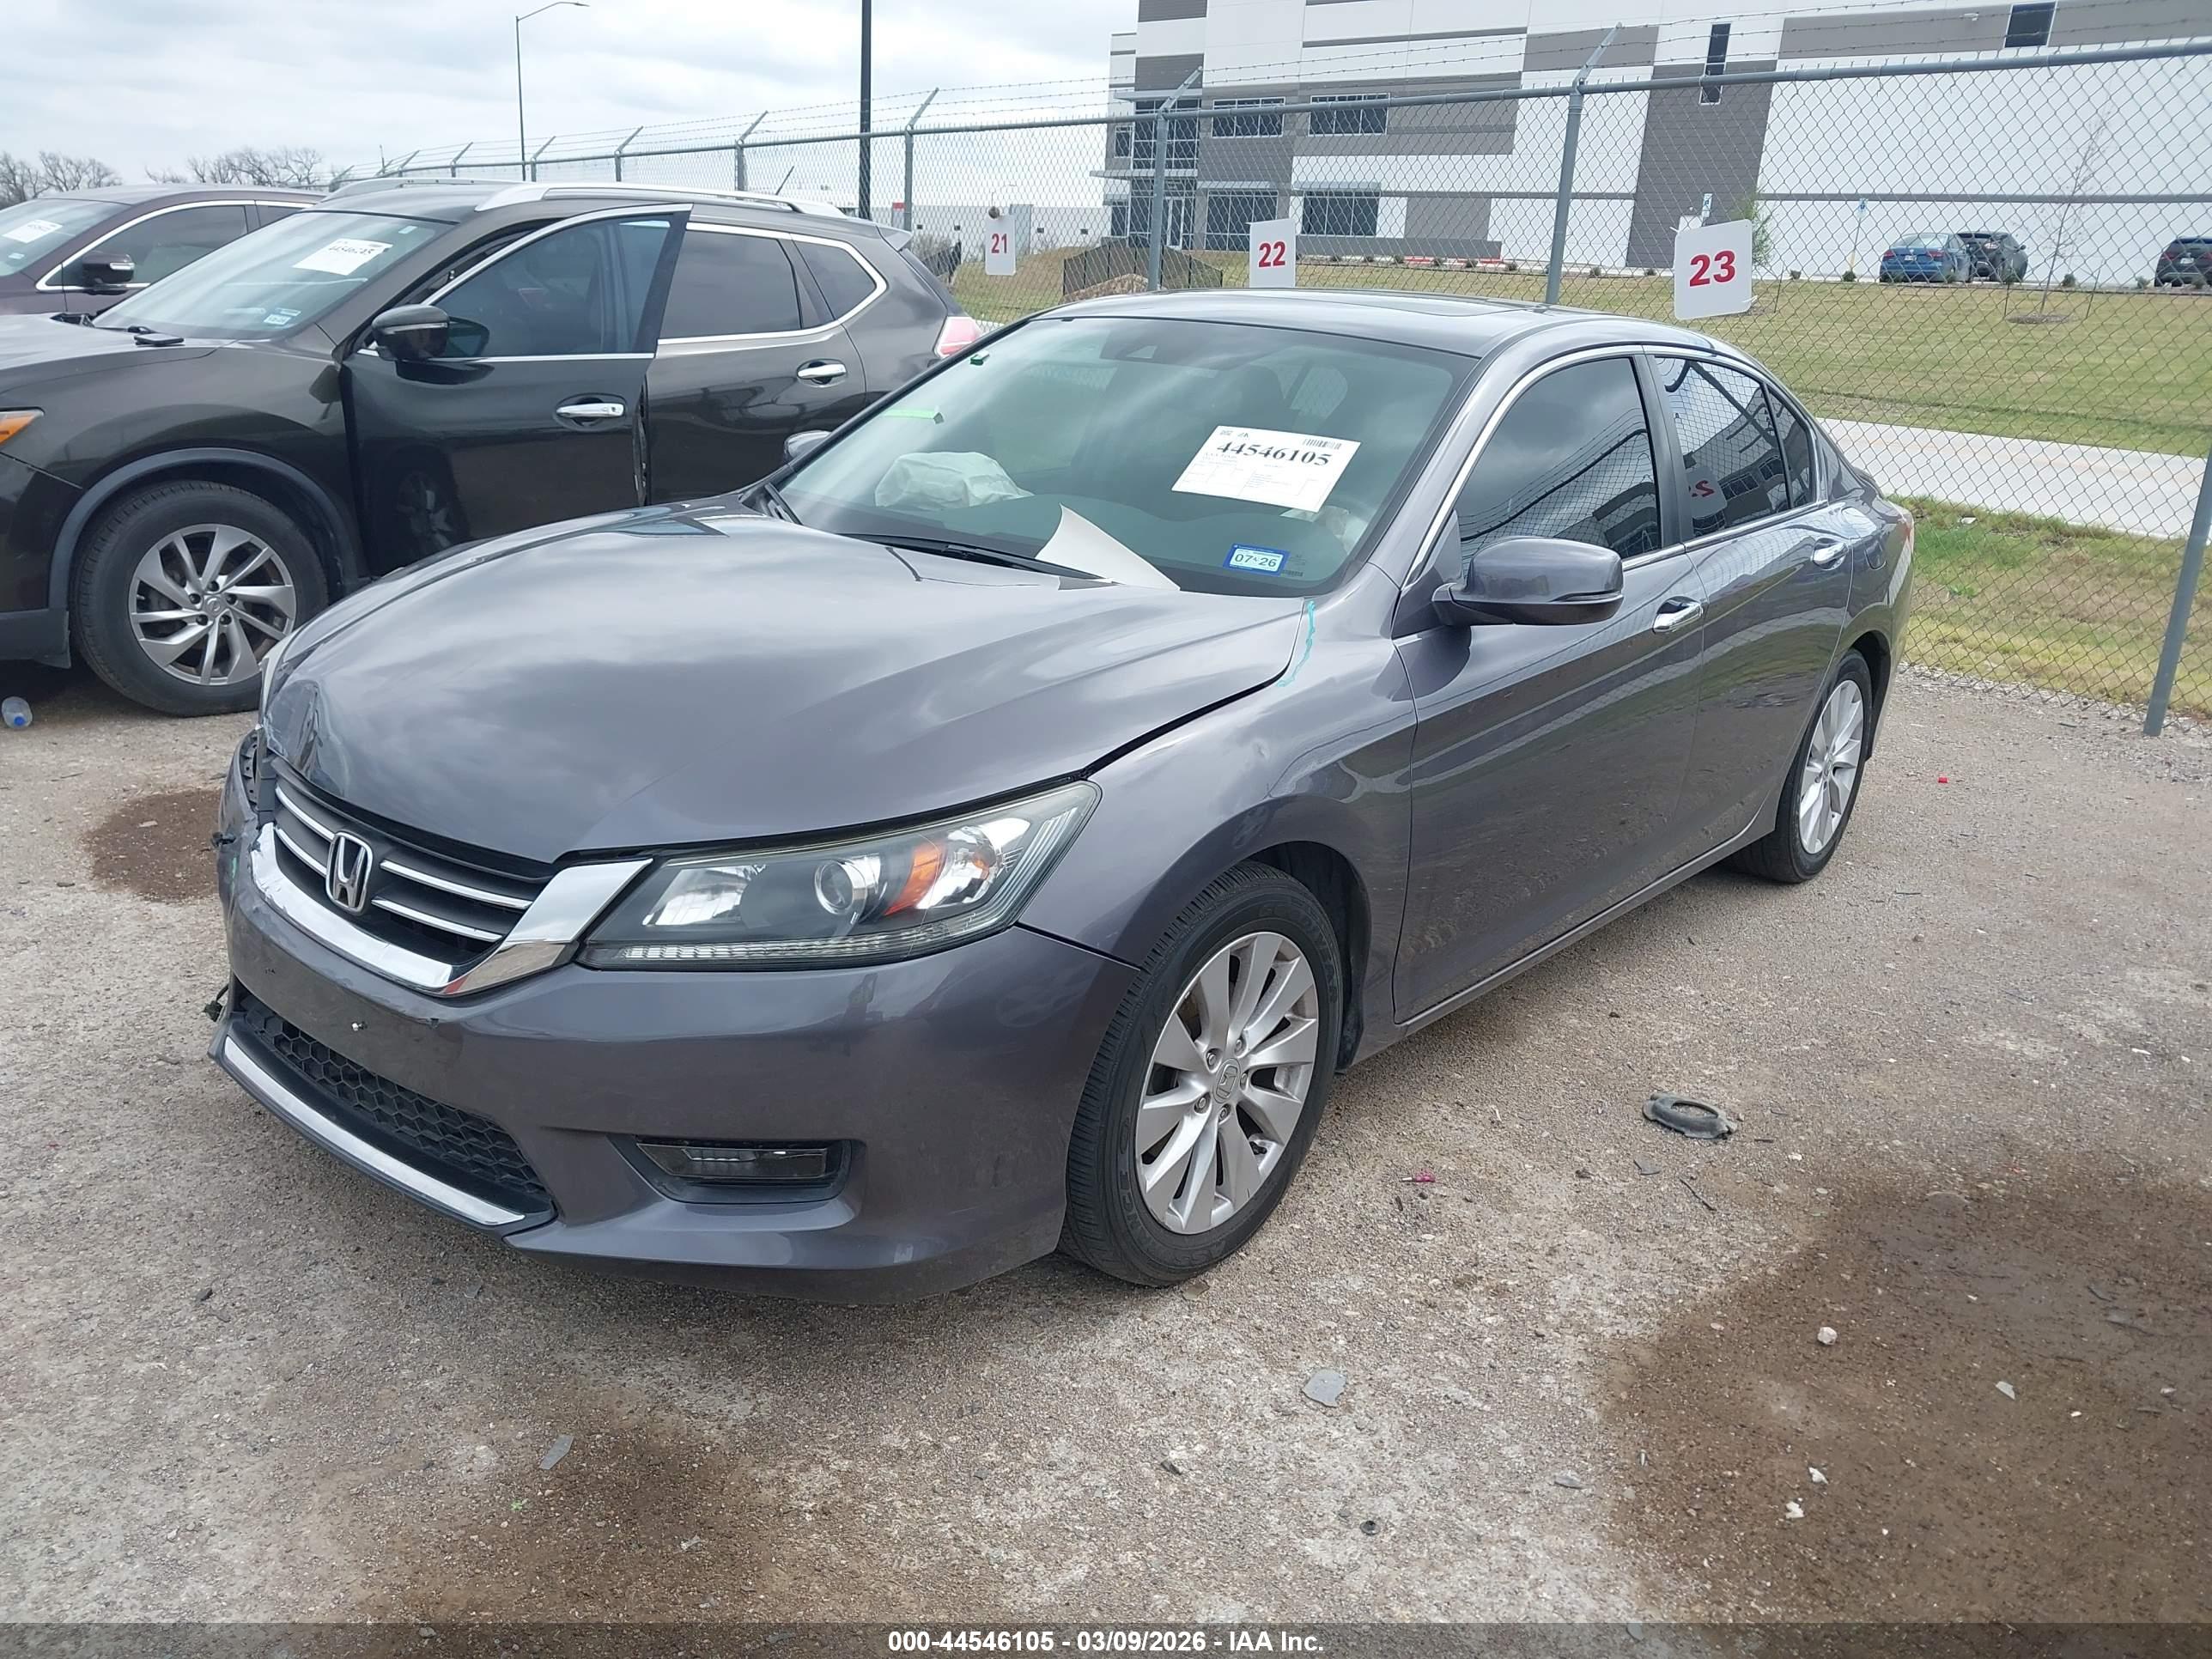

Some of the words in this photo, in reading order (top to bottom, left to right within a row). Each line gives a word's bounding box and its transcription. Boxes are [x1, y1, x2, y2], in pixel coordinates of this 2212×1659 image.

[991, 233, 1007, 253] 21
[1258, 240, 1286, 268] 22
[1689, 250, 1736, 288] 23
[1216, 441, 1333, 466] 44546105
[1234, 553, 1254, 563] 07
[1258, 556, 1277, 568] 26
